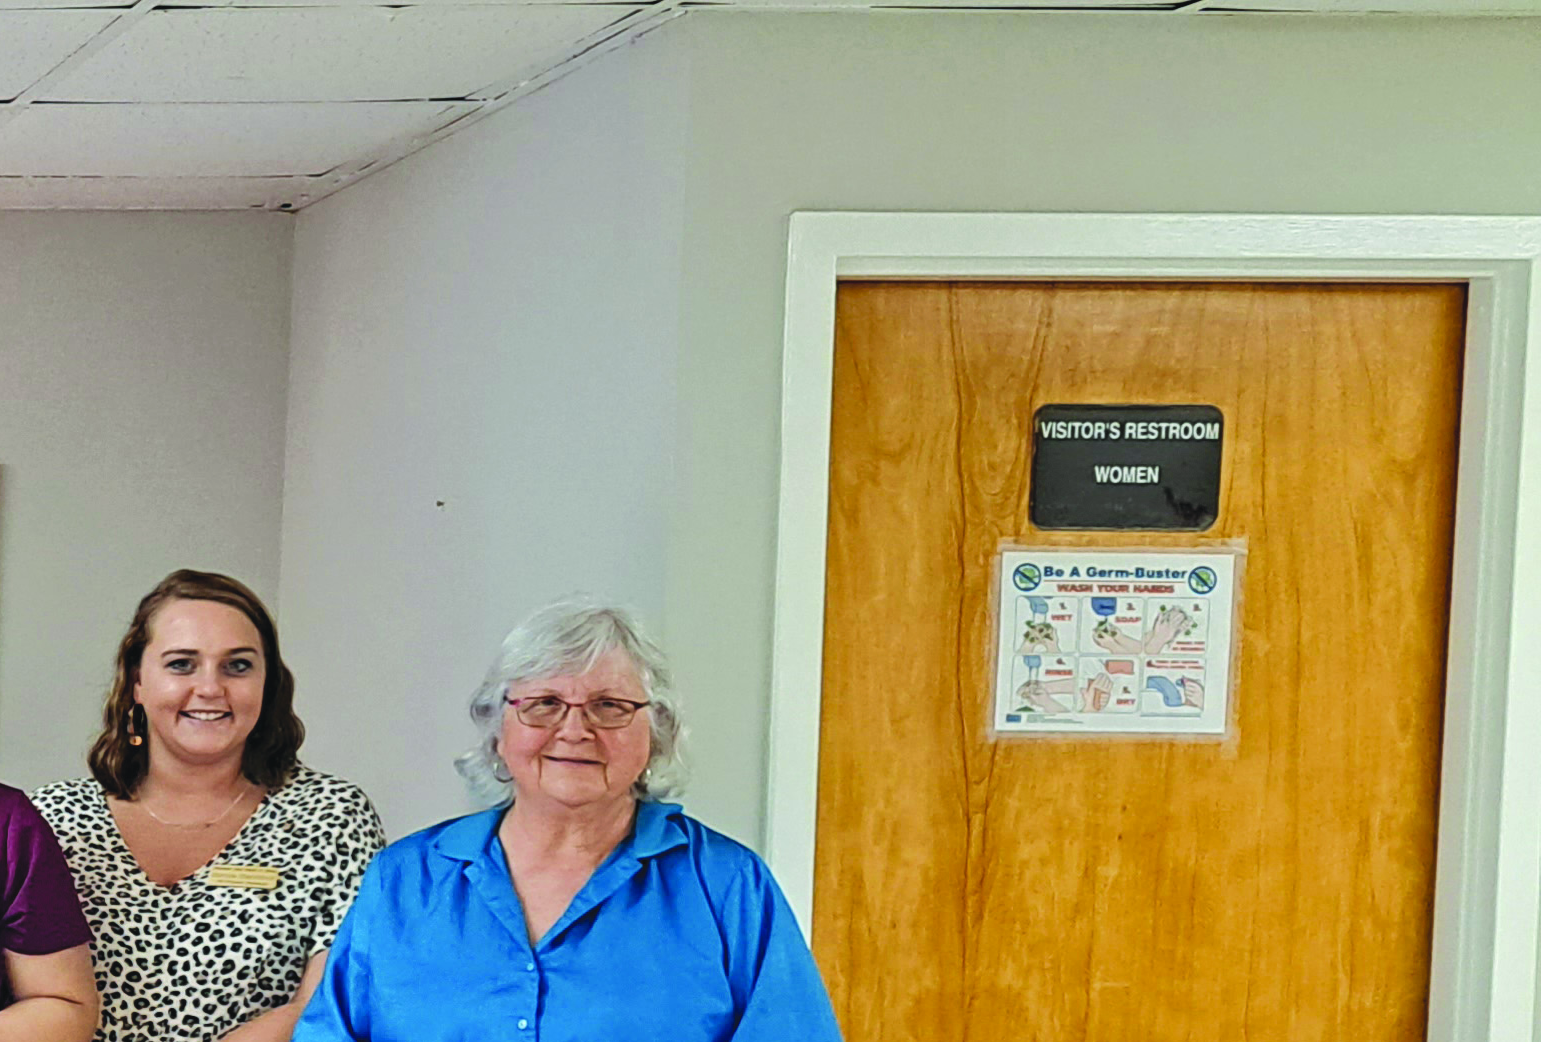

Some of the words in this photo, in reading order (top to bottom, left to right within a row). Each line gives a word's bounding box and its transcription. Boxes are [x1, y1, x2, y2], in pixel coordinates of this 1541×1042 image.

[1041, 421, 1121, 439] VISITOR'S
[1124, 422, 1220, 440] RESTROOM
[1094, 465, 1160, 484] WOMEN
[1043, 566, 1065, 578] Be
[1069, 566, 1081, 578] A
[1086, 567, 1188, 580] Germ-Buster
[1056, 583, 1094, 593] WASH
[1097, 584, 1130, 593] YOUR
